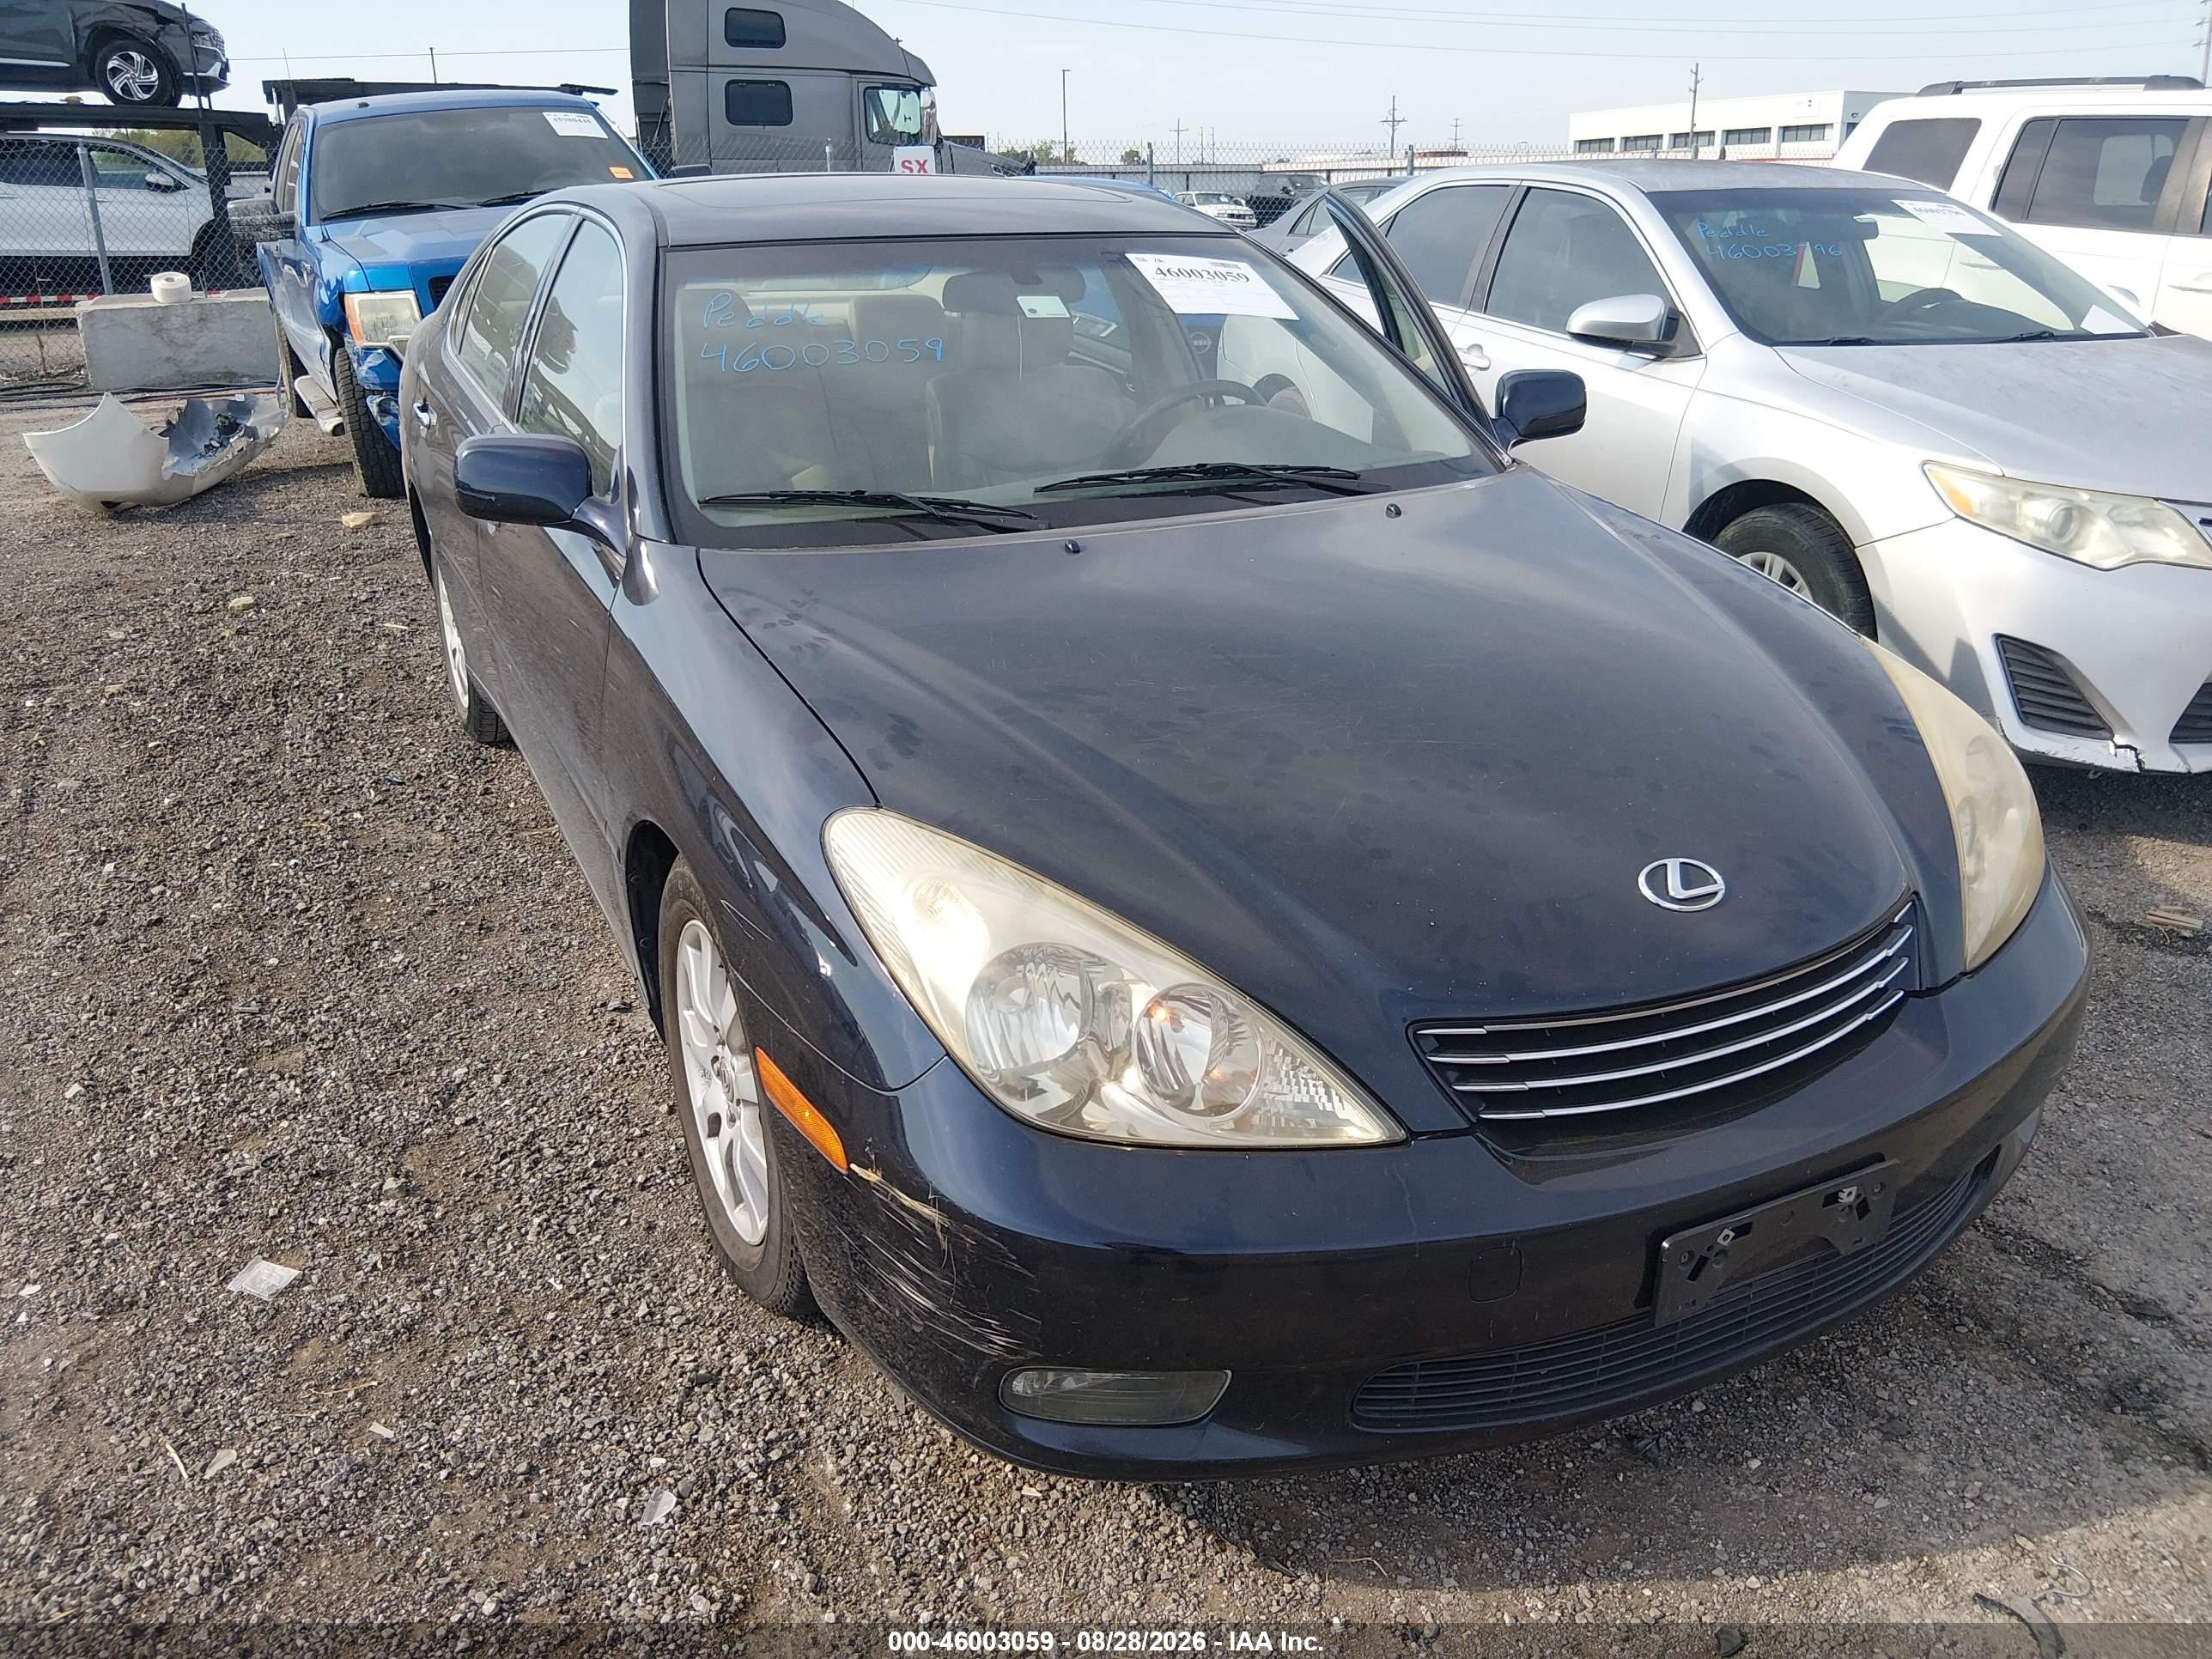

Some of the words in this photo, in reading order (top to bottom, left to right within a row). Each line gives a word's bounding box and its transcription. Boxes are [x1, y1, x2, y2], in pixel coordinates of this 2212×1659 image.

[901, 159, 928, 173] SX
[1155, 267, 1250, 283] 46003059
[701, 338, 943, 372] 46003059
